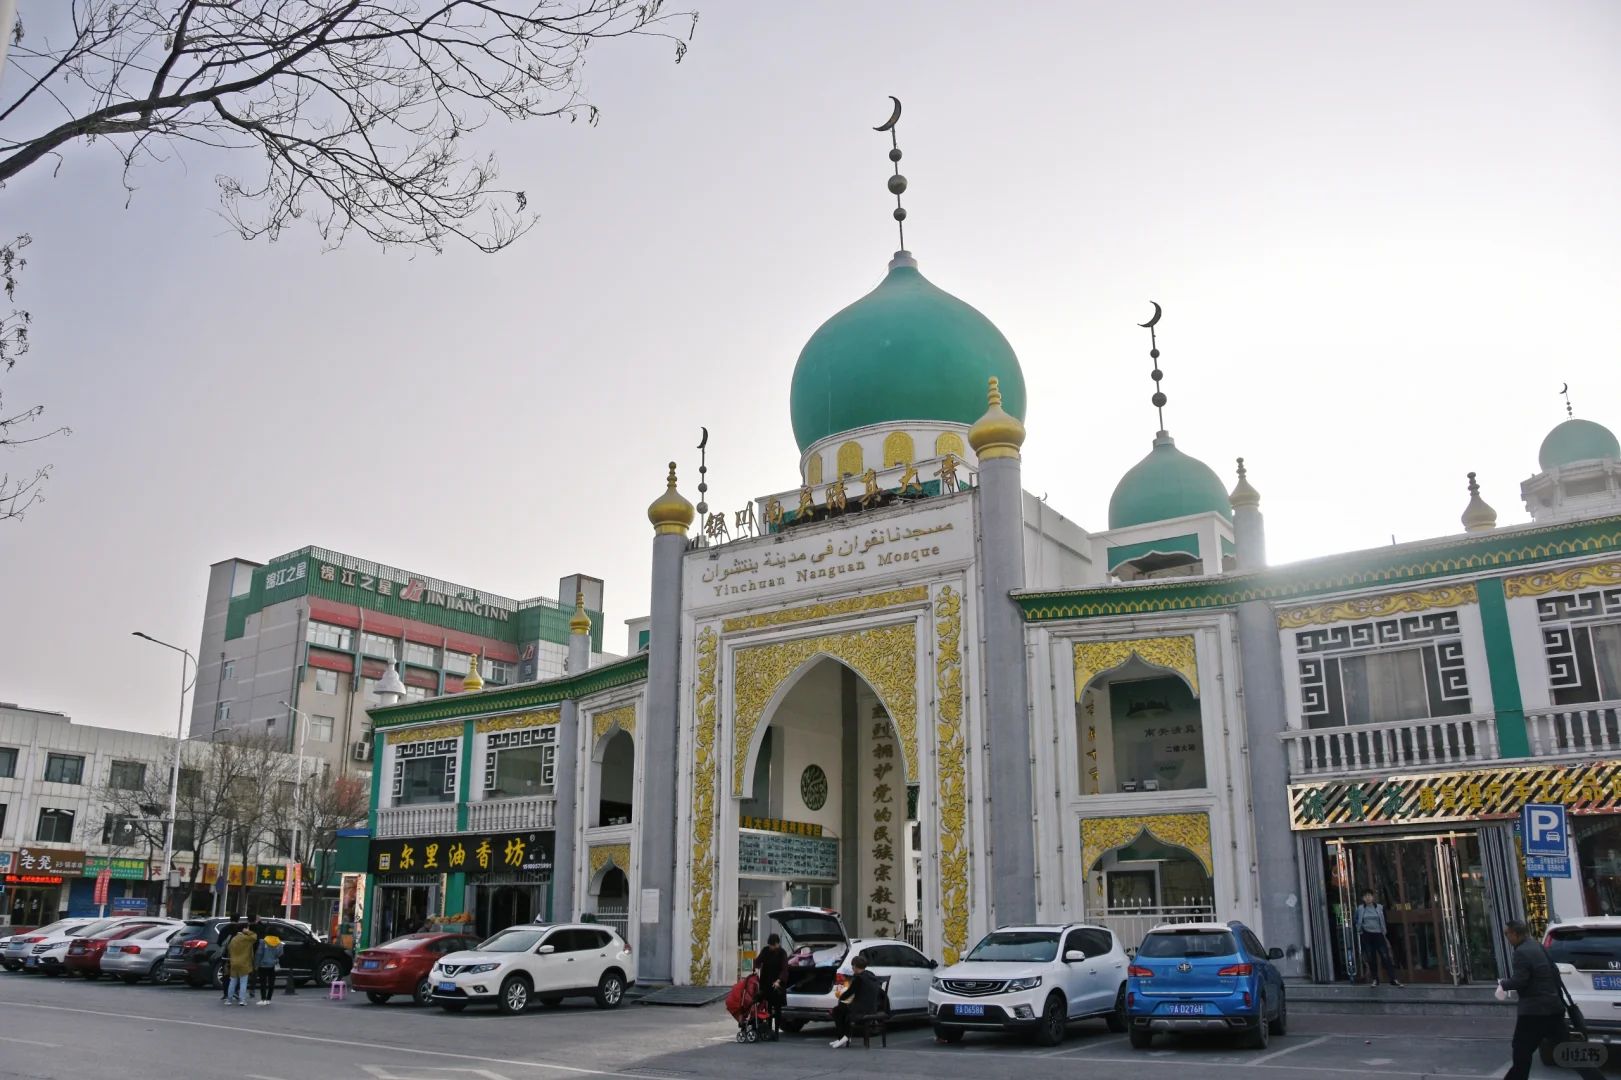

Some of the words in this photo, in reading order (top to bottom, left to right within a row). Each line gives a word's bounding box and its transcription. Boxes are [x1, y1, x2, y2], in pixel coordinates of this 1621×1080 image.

[704, 453, 960, 538] 银川南关清真大寺
[265, 561, 307, 590] 锦江之星
[320, 564, 393, 596] 锦江之星
[713, 576, 786, 597] Yinchuan
[796, 561, 866, 583] Nanguan
[878, 546, 940, 567] Mosque
[484, 605, 510, 622] INN
[1144, 724, 1203, 738] 南关清真
[739, 815, 822, 837] 真大寺军民共建专栏
[1531, 810, 1559, 841] P
[399, 837, 527, 870] 尔里油香坊
